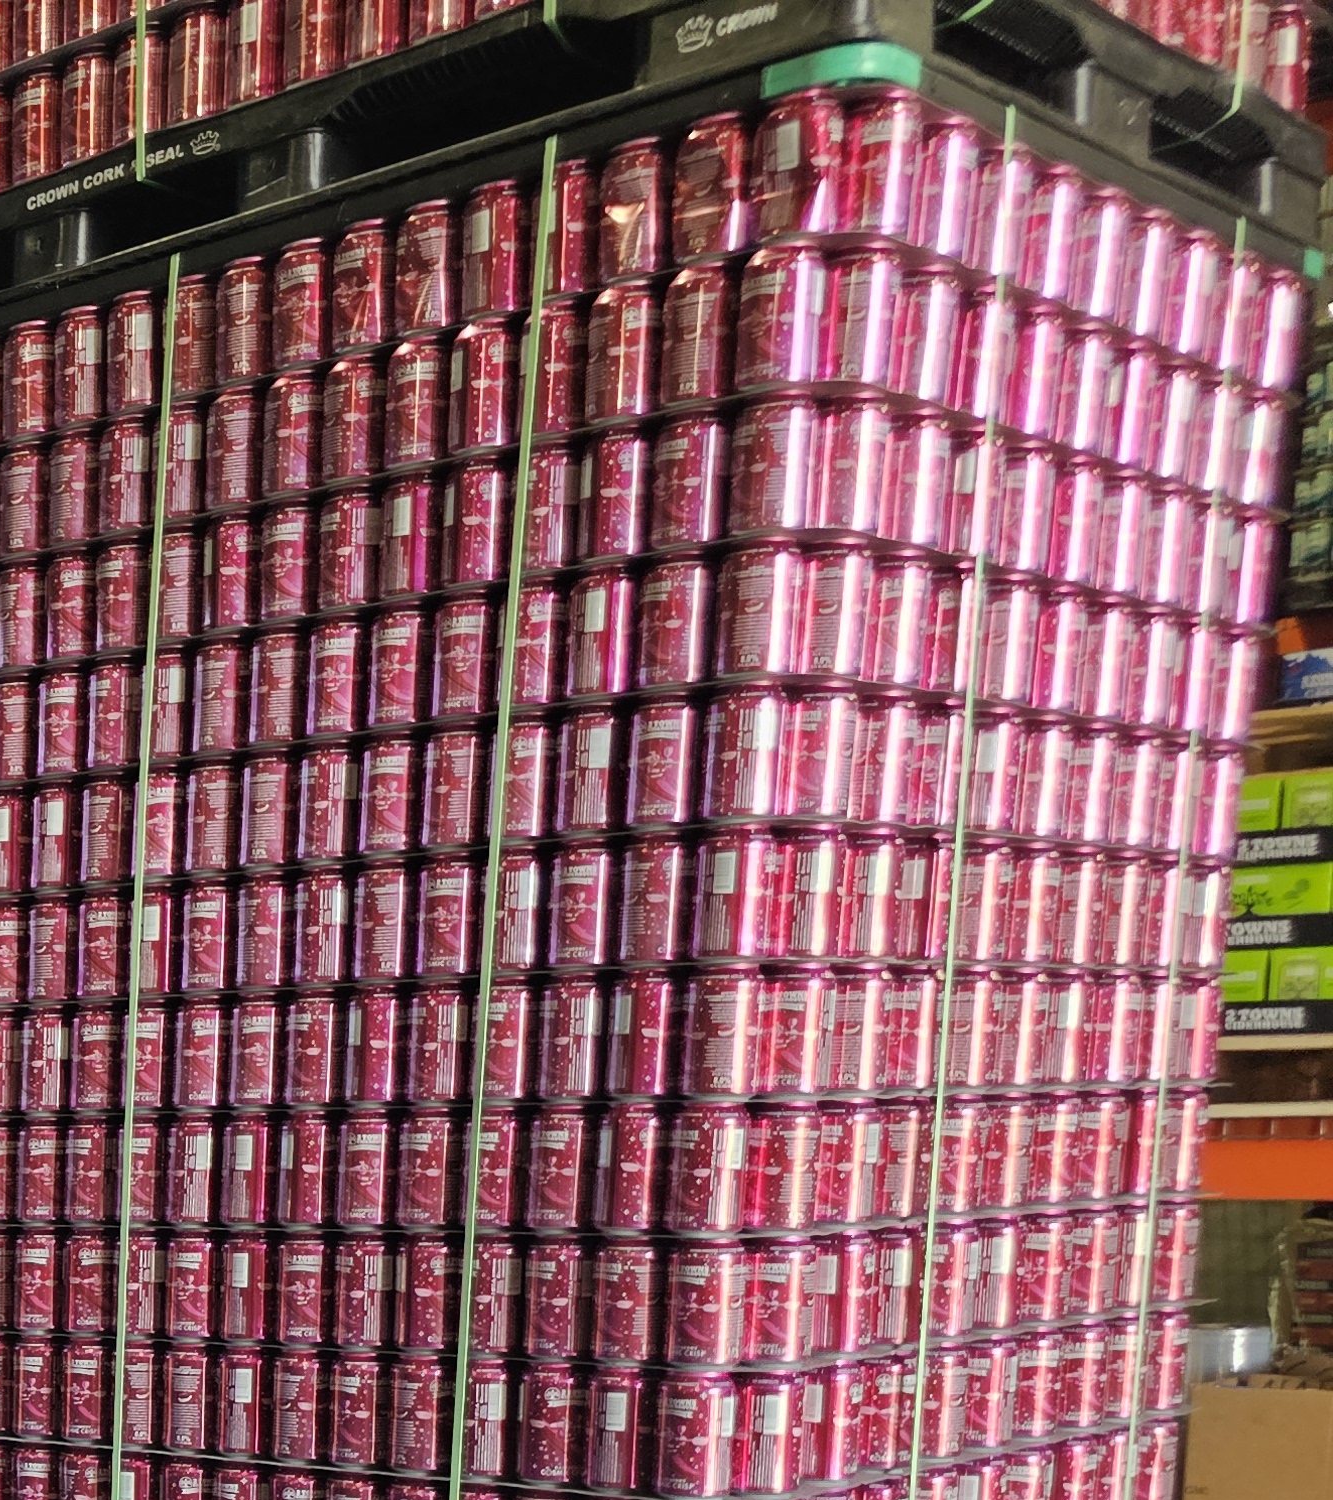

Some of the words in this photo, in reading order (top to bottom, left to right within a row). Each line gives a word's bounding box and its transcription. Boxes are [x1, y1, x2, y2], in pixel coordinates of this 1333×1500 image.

[26, 179, 79, 211] CROWN
[83, 163, 125, 190] CORK
[145, 144, 185, 168] SEAL
[1248, 834, 1319, 850] TOWNS
[1226, 919, 1292, 935] OWNS
[1237, 1006, 1304, 1022] TOWNS
